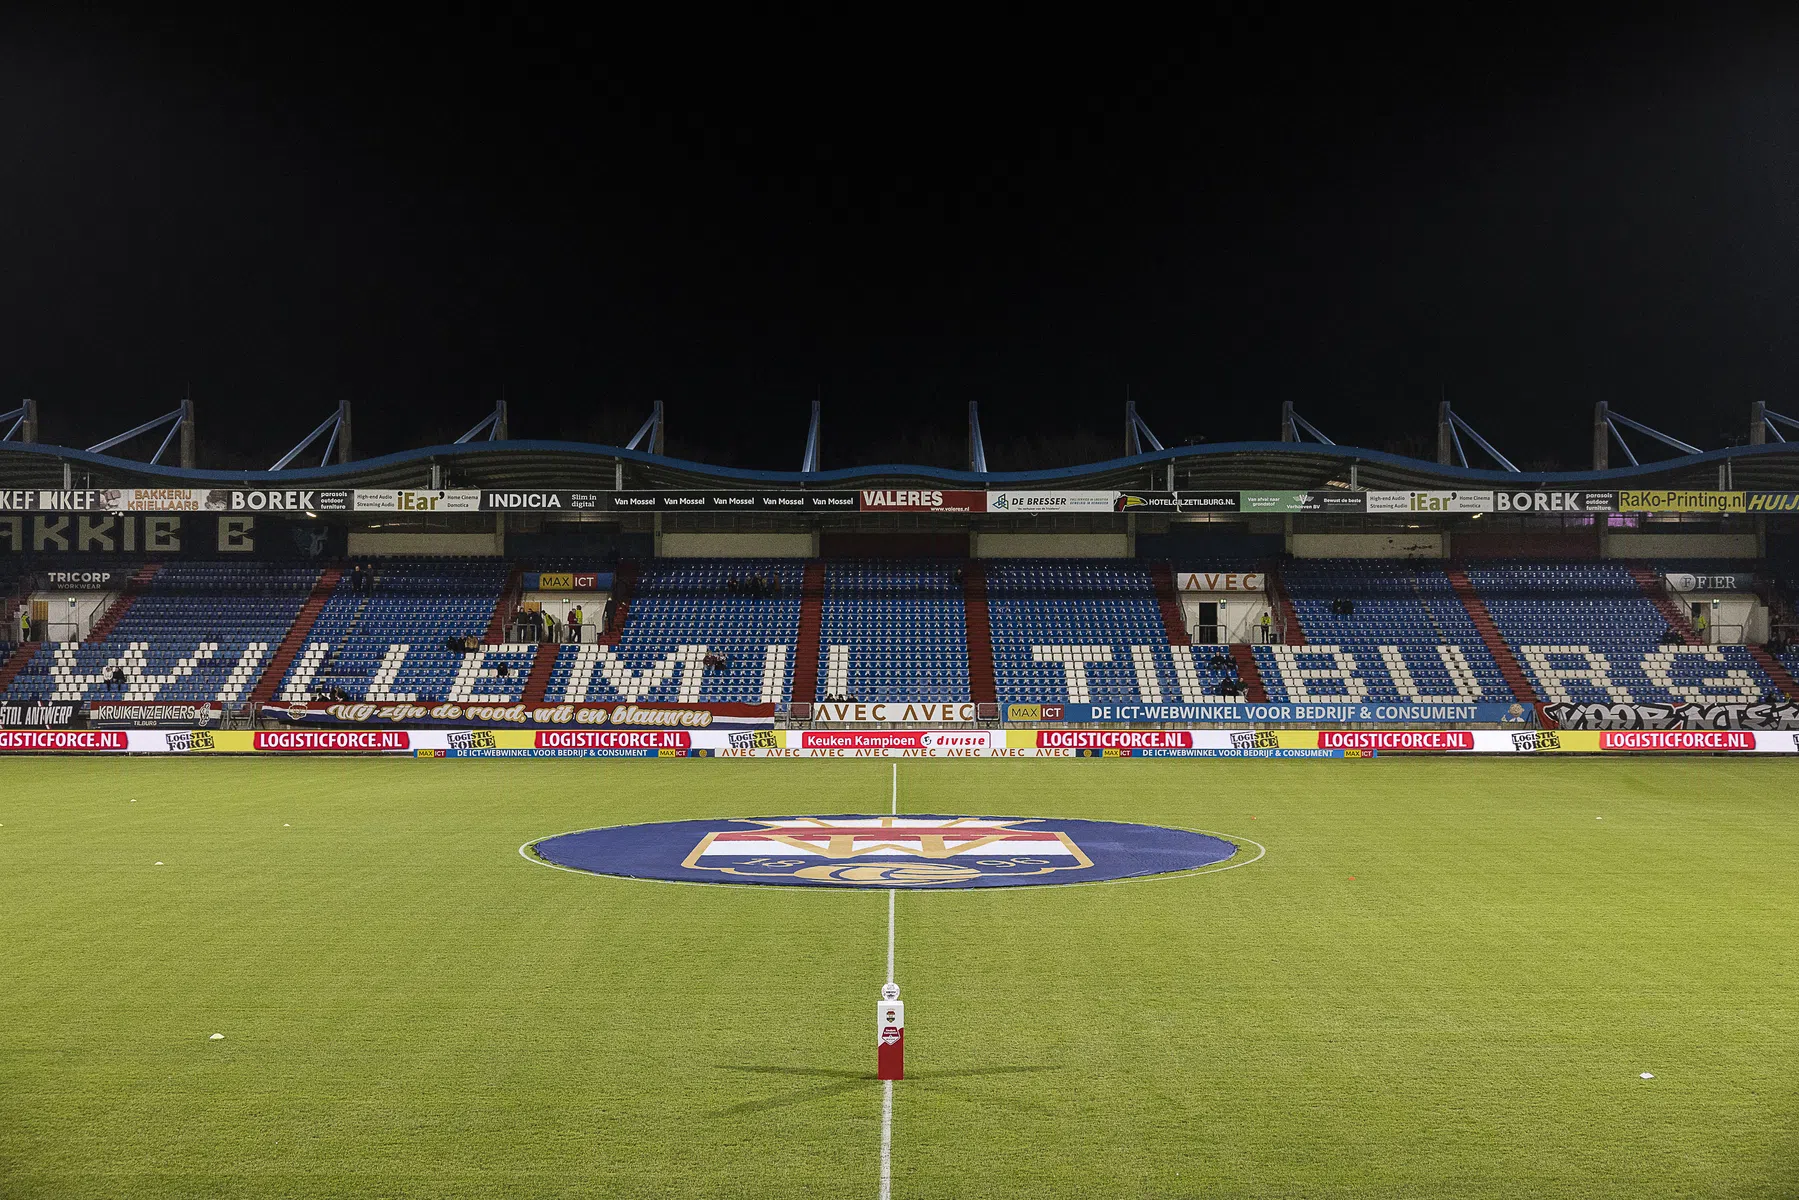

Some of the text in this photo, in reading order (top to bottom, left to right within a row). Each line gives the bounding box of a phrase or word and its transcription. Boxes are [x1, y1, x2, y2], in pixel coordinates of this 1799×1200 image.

[0, 491, 34, 510] KEF
[134, 490, 191, 500] BAKKERIJ
[232, 491, 314, 510] BOREK
[489, 494, 561, 507] INDICIA
[863, 491, 943, 506] VALERES
[1620, 492, 1746, 510] RaKo-Printing.nl
[128, 500, 199, 510] KRIELLAARS
[1498, 493, 1580, 511] BOREK
[1748, 494, 1799, 510] HUIJ
[48, 573, 110, 582] TRICORP
[542, 577, 594, 587] MAX ICT
[1185, 574, 1257, 590] AVEC
[1697, 577, 1737, 589] FIER
[25, 706, 73, 725] ANTWERP
[98, 705, 195, 720] KRUIKENZEIKERS
[431, 704, 462, 719] de
[533, 705, 574, 724] wit
[576, 708, 608, 725] en
[610, 705, 713, 727] blauwen
[816, 704, 973, 721] AVEC AVEC
[1011, 708, 1061, 717] MAX ICT
[1092, 706, 1477, 722] DE ICT-WEBWINKEL VOOR BEDRIJF & CONSUMENT
[0, 733, 120, 747] GISTICFORCE.NL
[168, 732, 210, 742] LOGISTIC
[260, 733, 402, 747] LOGISTICFORCE.NL
[450, 731, 492, 742] LOGISTIC
[542, 733, 684, 747] LOGISTICFORCE.NL
[731, 731, 774, 742] LOGISTIC
[808, 736, 915, 747] Keuken Kampioen
[937, 736, 985, 745] divisie
[1043, 733, 1185, 747] LOGISTICFORCE.NL
[1233, 731, 1275, 742] LOGISTIC
[1325, 733, 1466, 747] LOGISTICFORCE.NL
[1514, 731, 1556, 742] LOGISTIC
[1606, 733, 1748, 747] LOGISTICFORCE.NL
[170, 737, 213, 750] FORCE
[451, 738, 494, 749] FORCE
[731, 738, 776, 748] FORCE
[1233, 738, 1277, 749] FORCE
[1515, 738, 1559, 750] FORCE
[558, 750, 587, 758] BEDRIJF
[1244, 750, 1273, 758] BEDRIJF
[976, 857, 1050, 868] 96
